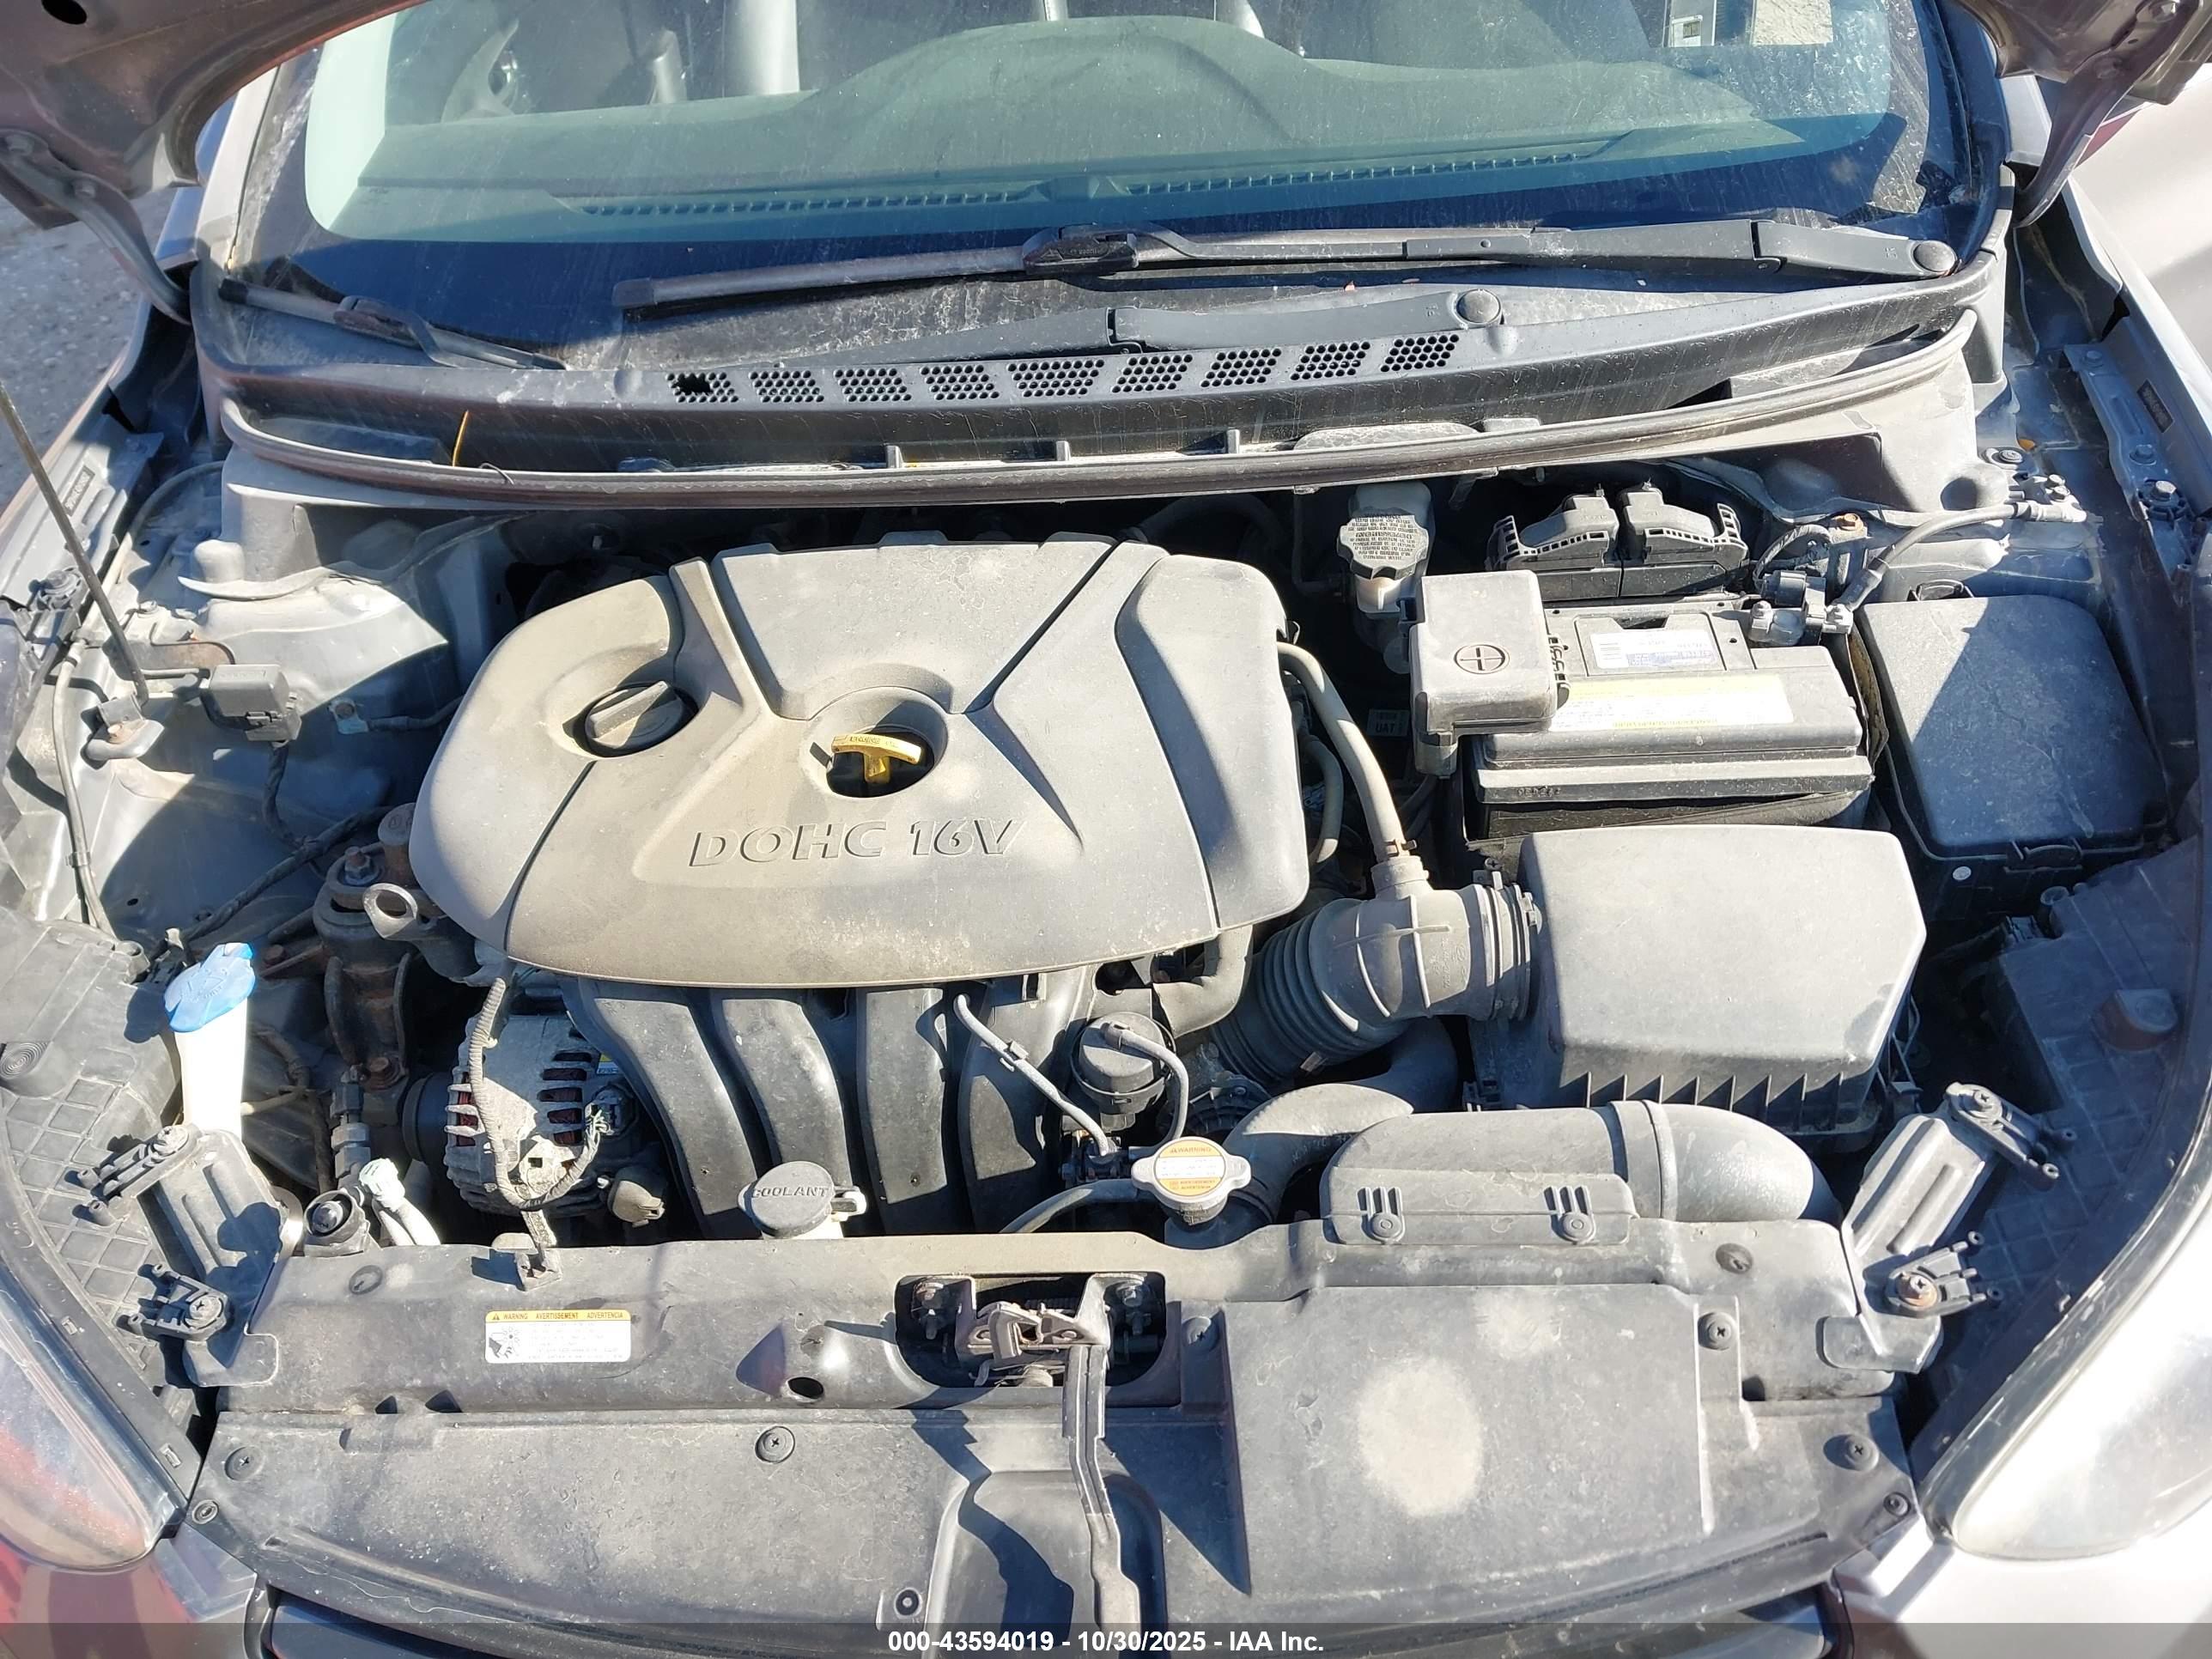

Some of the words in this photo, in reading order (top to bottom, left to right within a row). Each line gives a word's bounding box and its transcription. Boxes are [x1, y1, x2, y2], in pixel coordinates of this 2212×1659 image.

[688, 821, 888, 867] DOHC
[909, 818, 1022, 857] 16V
[753, 1186, 829, 1198] COOLANT
[535, 1311, 579, 1320] AVERTISSEMENT
[586, 1310, 623, 1319] ADVERTENCIA
